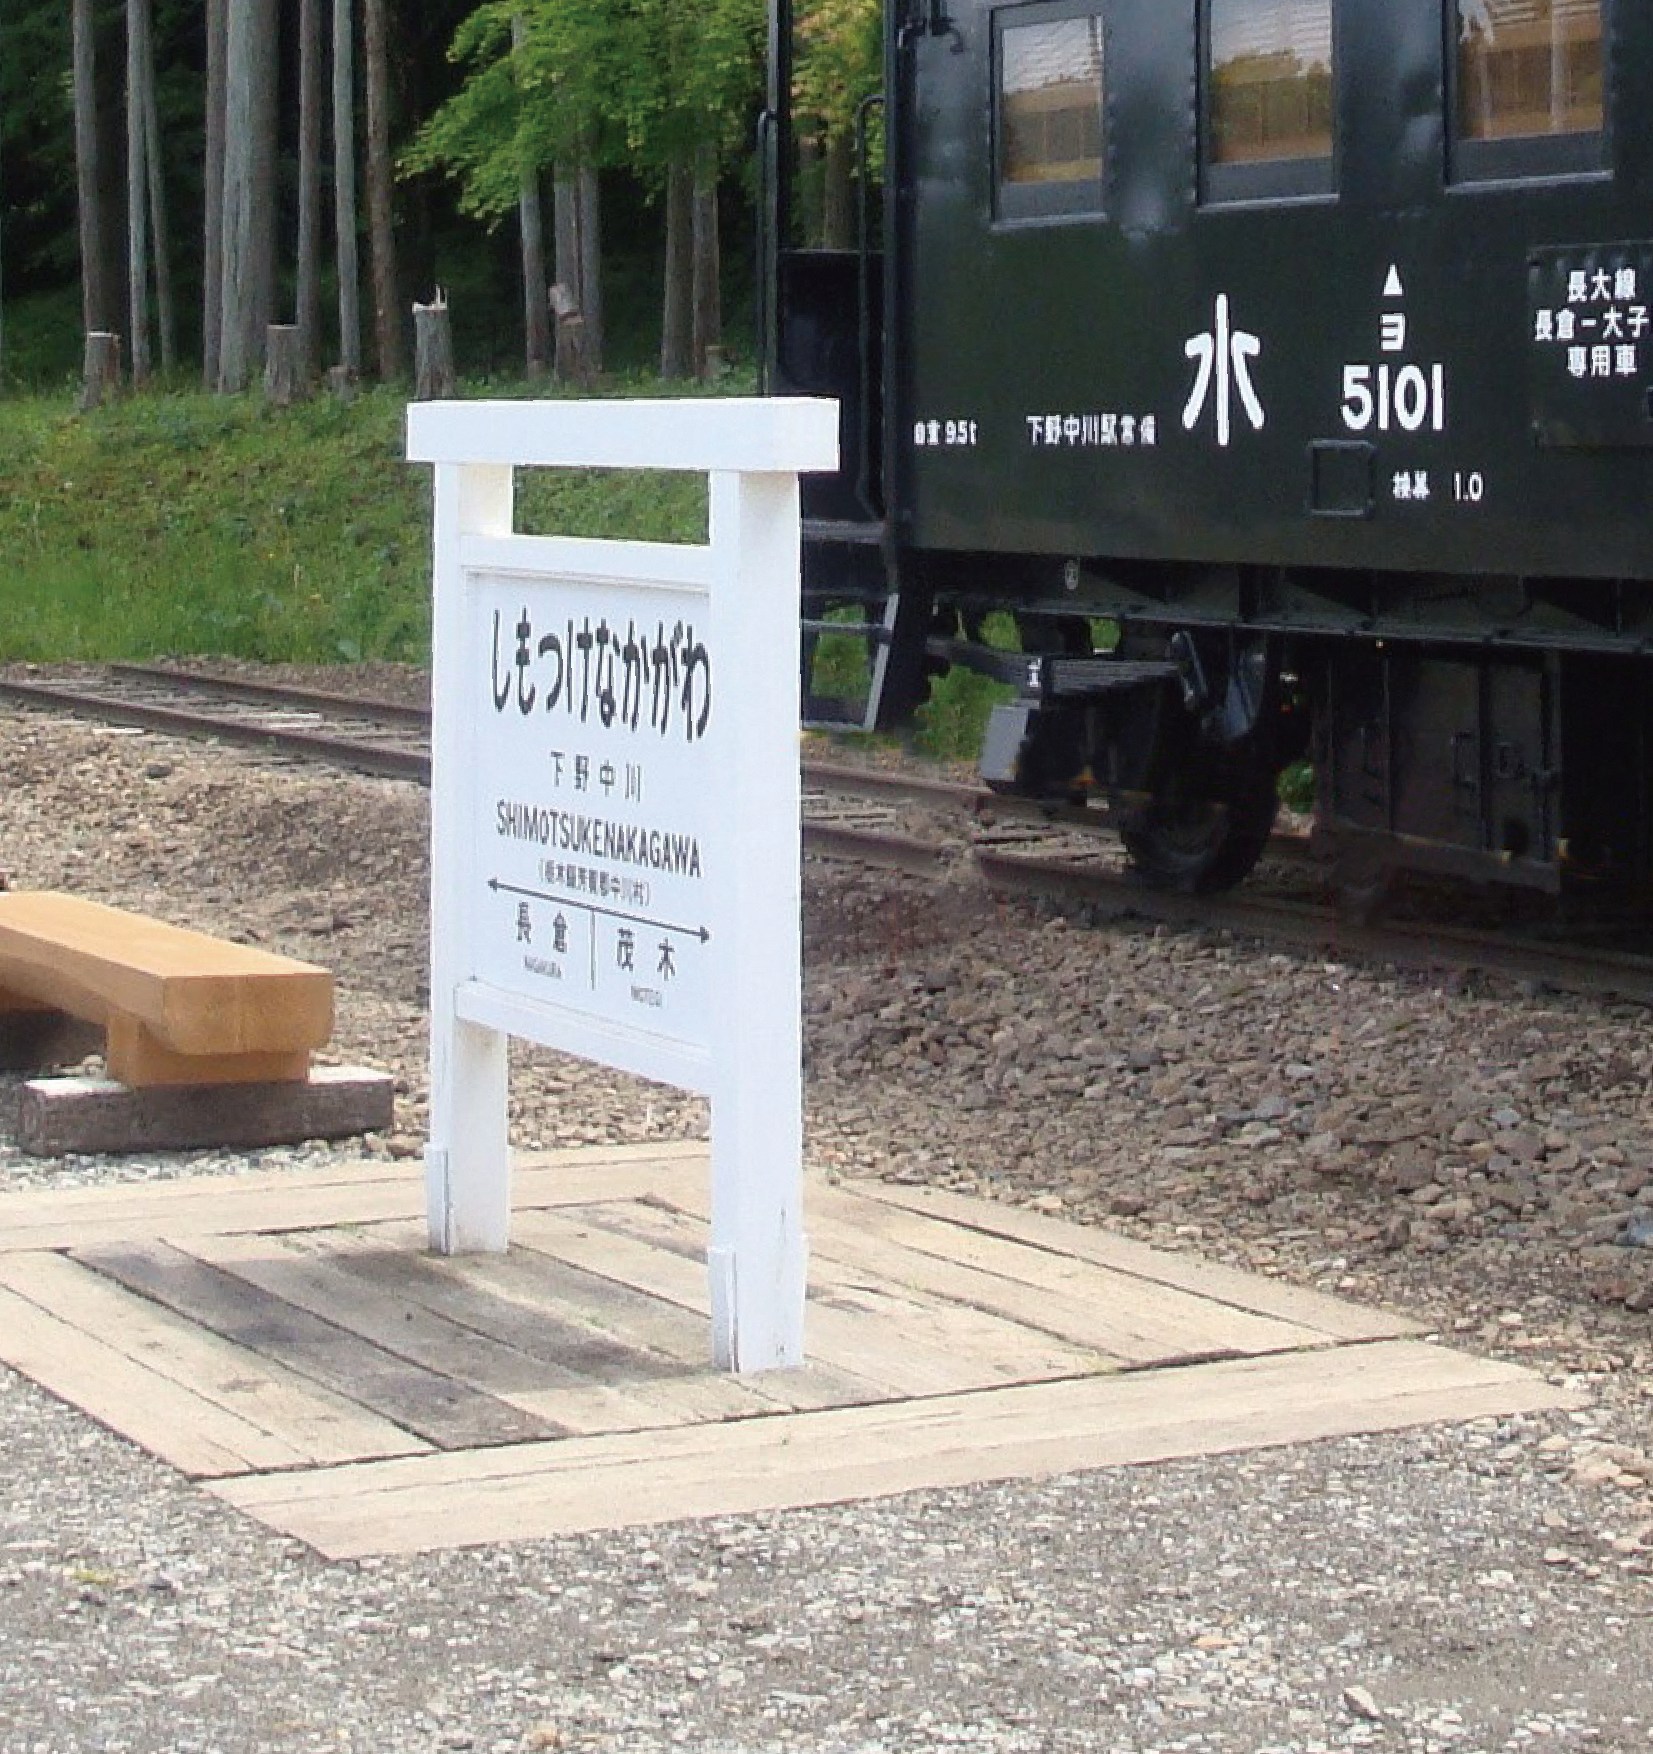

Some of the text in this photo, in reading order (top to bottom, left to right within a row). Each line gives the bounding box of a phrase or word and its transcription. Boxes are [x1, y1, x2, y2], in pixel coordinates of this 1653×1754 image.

[1181, 292, 1265, 446] 水
[1339, 362, 1444, 432] 5101
[1455, 471, 1484, 502] 1.0
[491, 605, 711, 742] しもつけなかがわ
[550, 750, 641, 803] 下野中川
[496, 798, 702, 879] SHIMOTSUKENAKAGAWA
[615, 927, 677, 981] 茂木
